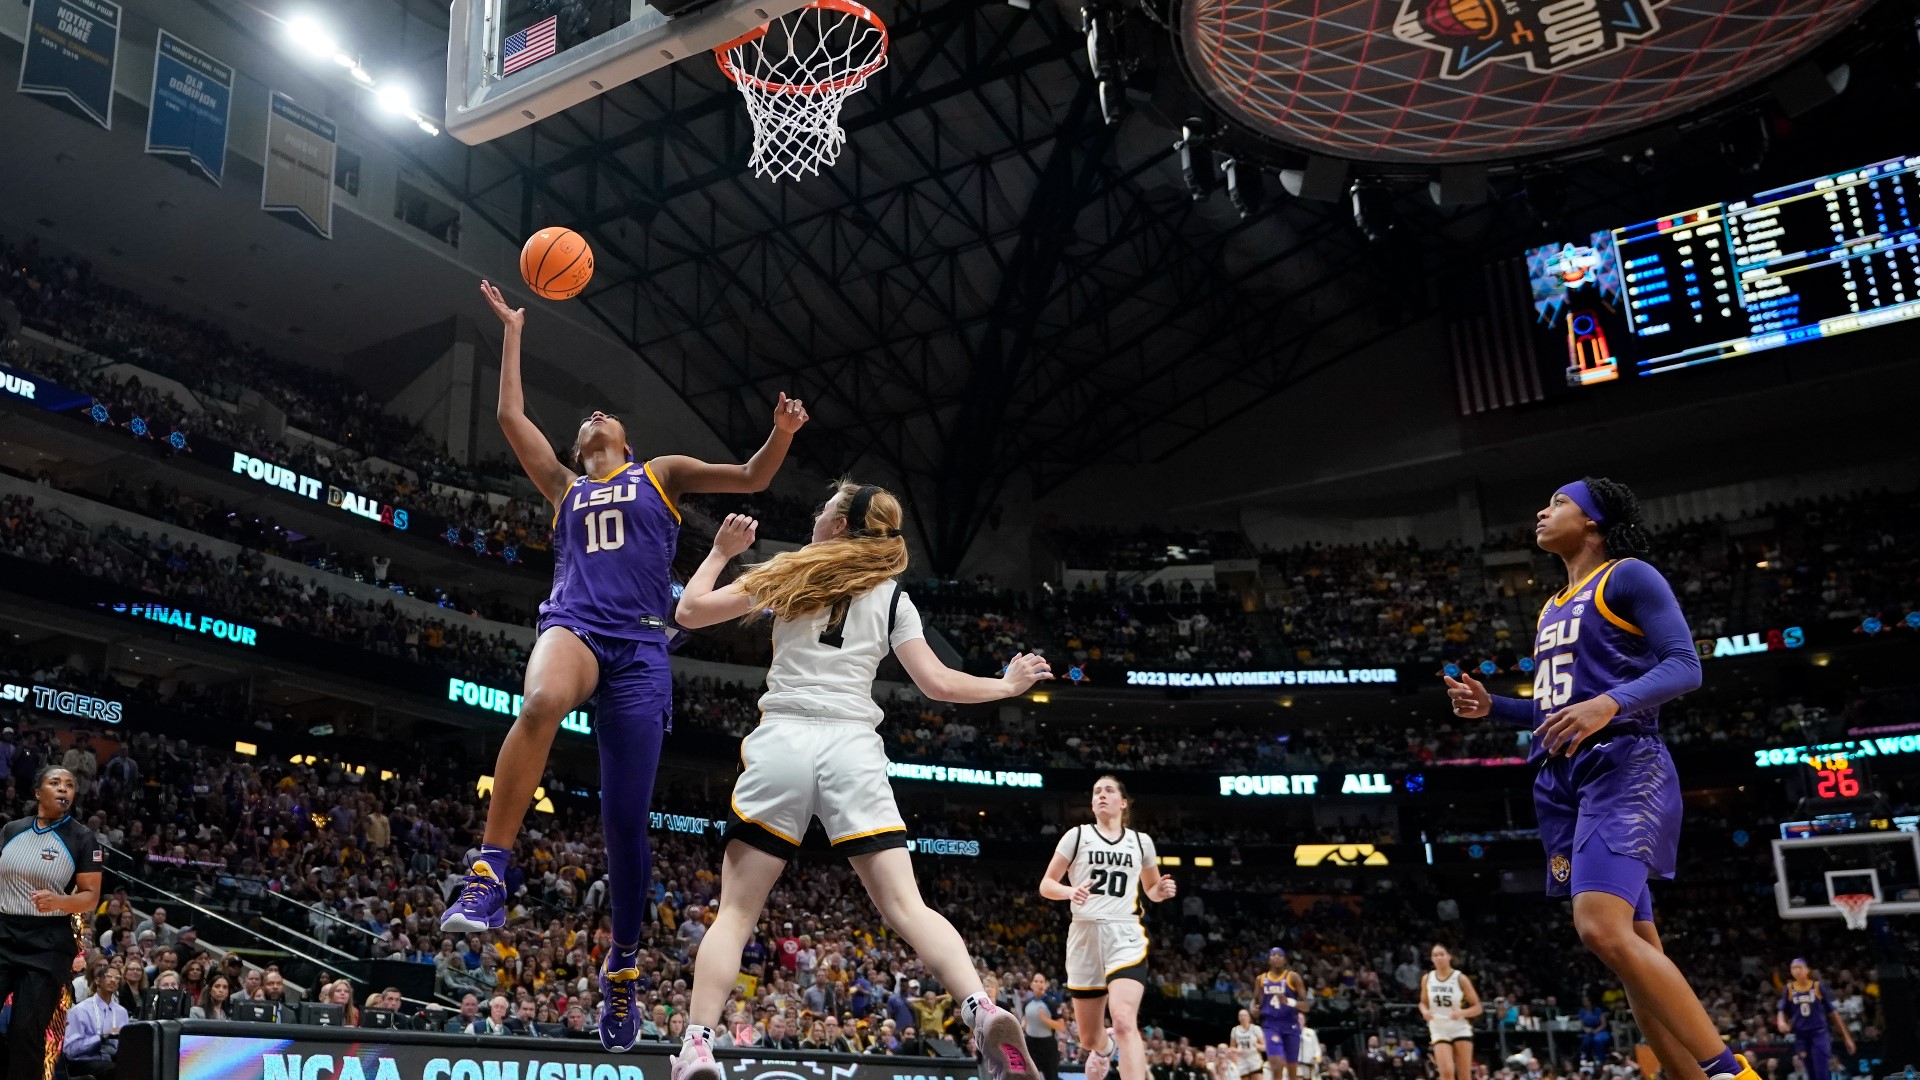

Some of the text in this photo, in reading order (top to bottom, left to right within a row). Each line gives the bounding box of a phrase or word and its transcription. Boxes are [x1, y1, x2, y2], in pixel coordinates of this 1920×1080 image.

[57, 6, 93, 33] NOTRE
[57, 19, 89, 43] DAME
[169, 77, 217, 108] DOMINION
[185, 74, 204, 90] OLD
[232, 451, 409, 530] FOUR IT DALLAS
[572, 484, 637, 512] LSU
[584, 508, 625, 554] 10
[200, 615, 258, 646] FOUR
[1534, 617, 1581, 658] SU
[1126, 668, 1397, 686] 2023 NCAA WOMEN'S FINAL FOUR
[1533, 652, 1574, 711] 45
[32, 685, 122, 724] TIGERS
[448, 677, 510, 715] FOUR
[886, 762, 1044, 788] OMEN'S FINAL FOUR
[1219, 773, 1393, 796] FOUR IT ALL
[1816, 768, 1860, 798] 26
[917, 837, 981, 857] TIGERS
[1088, 850, 1134, 868] IOWA
[1088, 868, 1129, 898] 20
[1269, 994, 1281, 1010] 4
[1433, 994, 1453, 1008] 45
